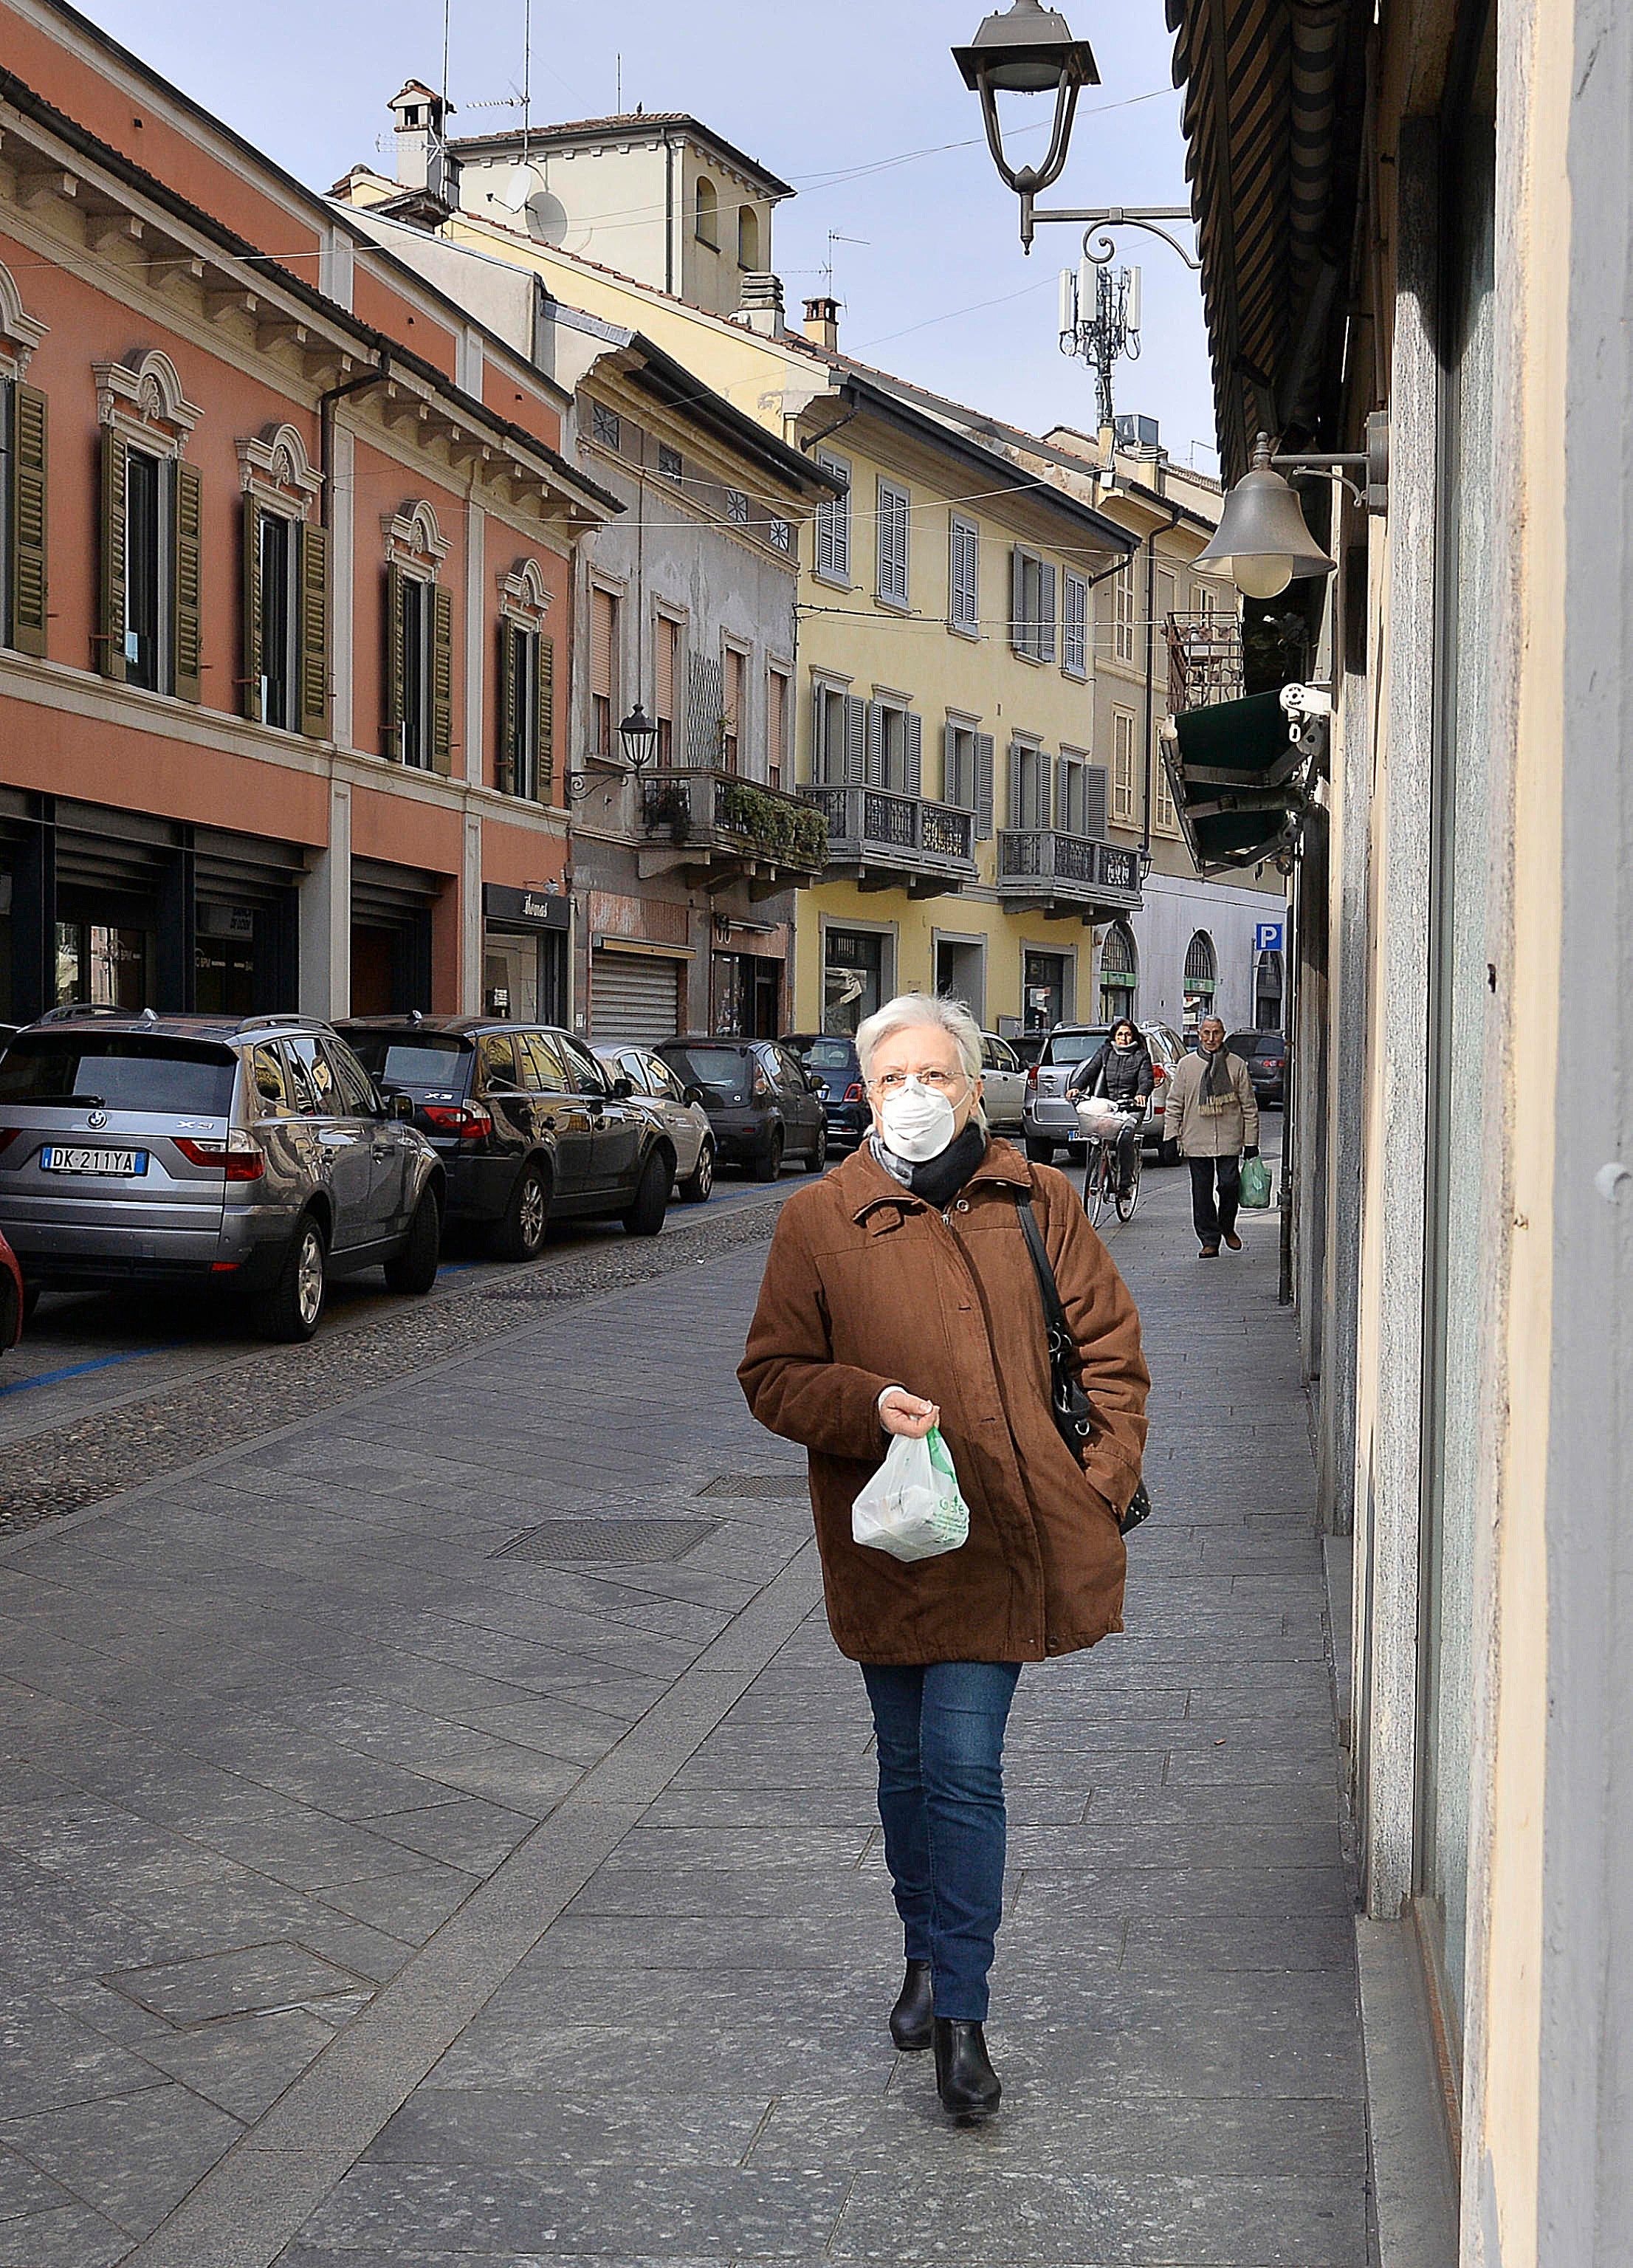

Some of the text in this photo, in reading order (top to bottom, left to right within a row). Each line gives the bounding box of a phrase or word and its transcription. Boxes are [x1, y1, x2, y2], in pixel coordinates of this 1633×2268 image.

[1261, 926, 1277, 948] P
[424, 1092, 453, 1100] X3
[176, 1119, 214, 1130] X3
